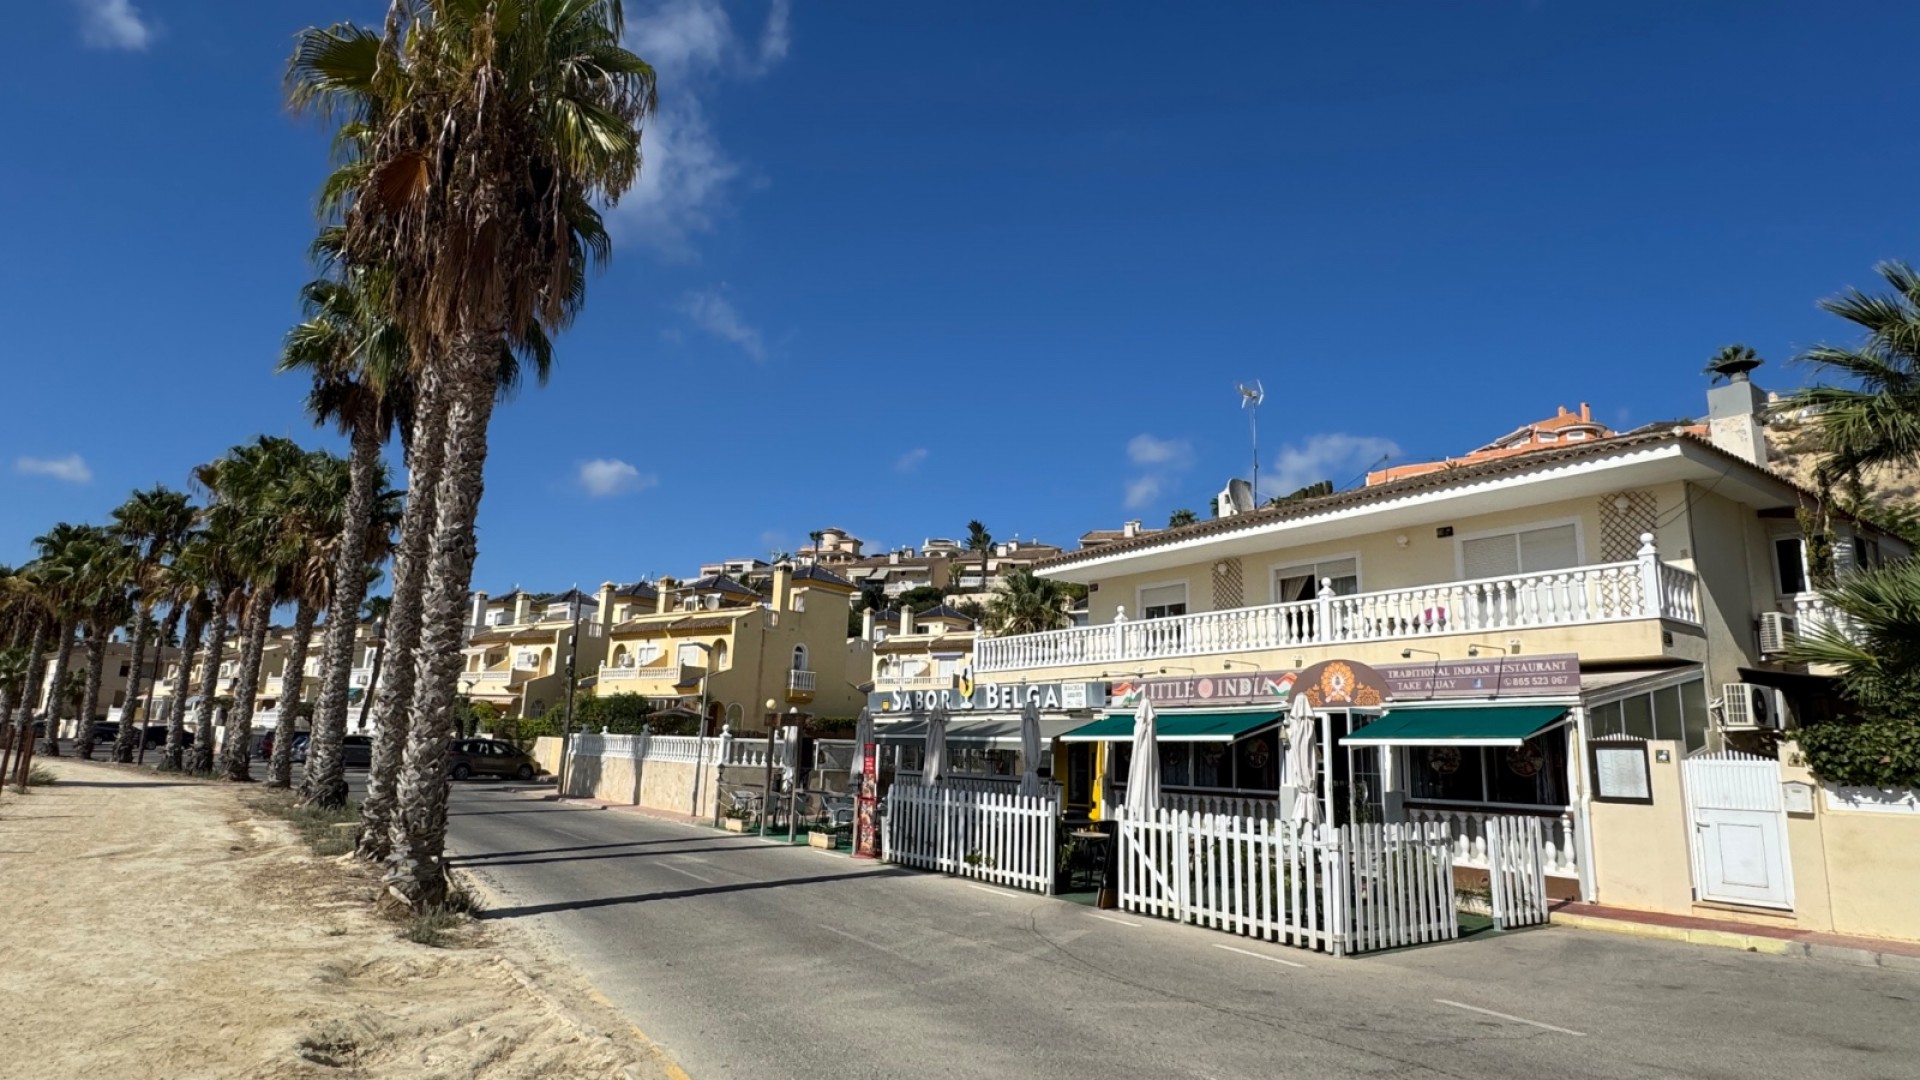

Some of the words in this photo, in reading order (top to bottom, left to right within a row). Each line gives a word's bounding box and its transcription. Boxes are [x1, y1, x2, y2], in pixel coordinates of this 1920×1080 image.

[1388, 668, 1449, 678] TRADITIONAL
[1453, 666, 1489, 676] INDIAN
[1494, 661, 1567, 673] RESTAURANT
[1143, 680, 1195, 700] LITTLE
[1217, 676, 1274, 697] INDIA
[1397, 681, 1422, 691] TAKE
[1424, 680, 1456, 690] AWAY
[1532, 676, 1549, 686] 523
[1551, 675, 1569, 685] 067
[892, 689, 950, 711] SABOR
[986, 683, 1059, 708] BELGA
